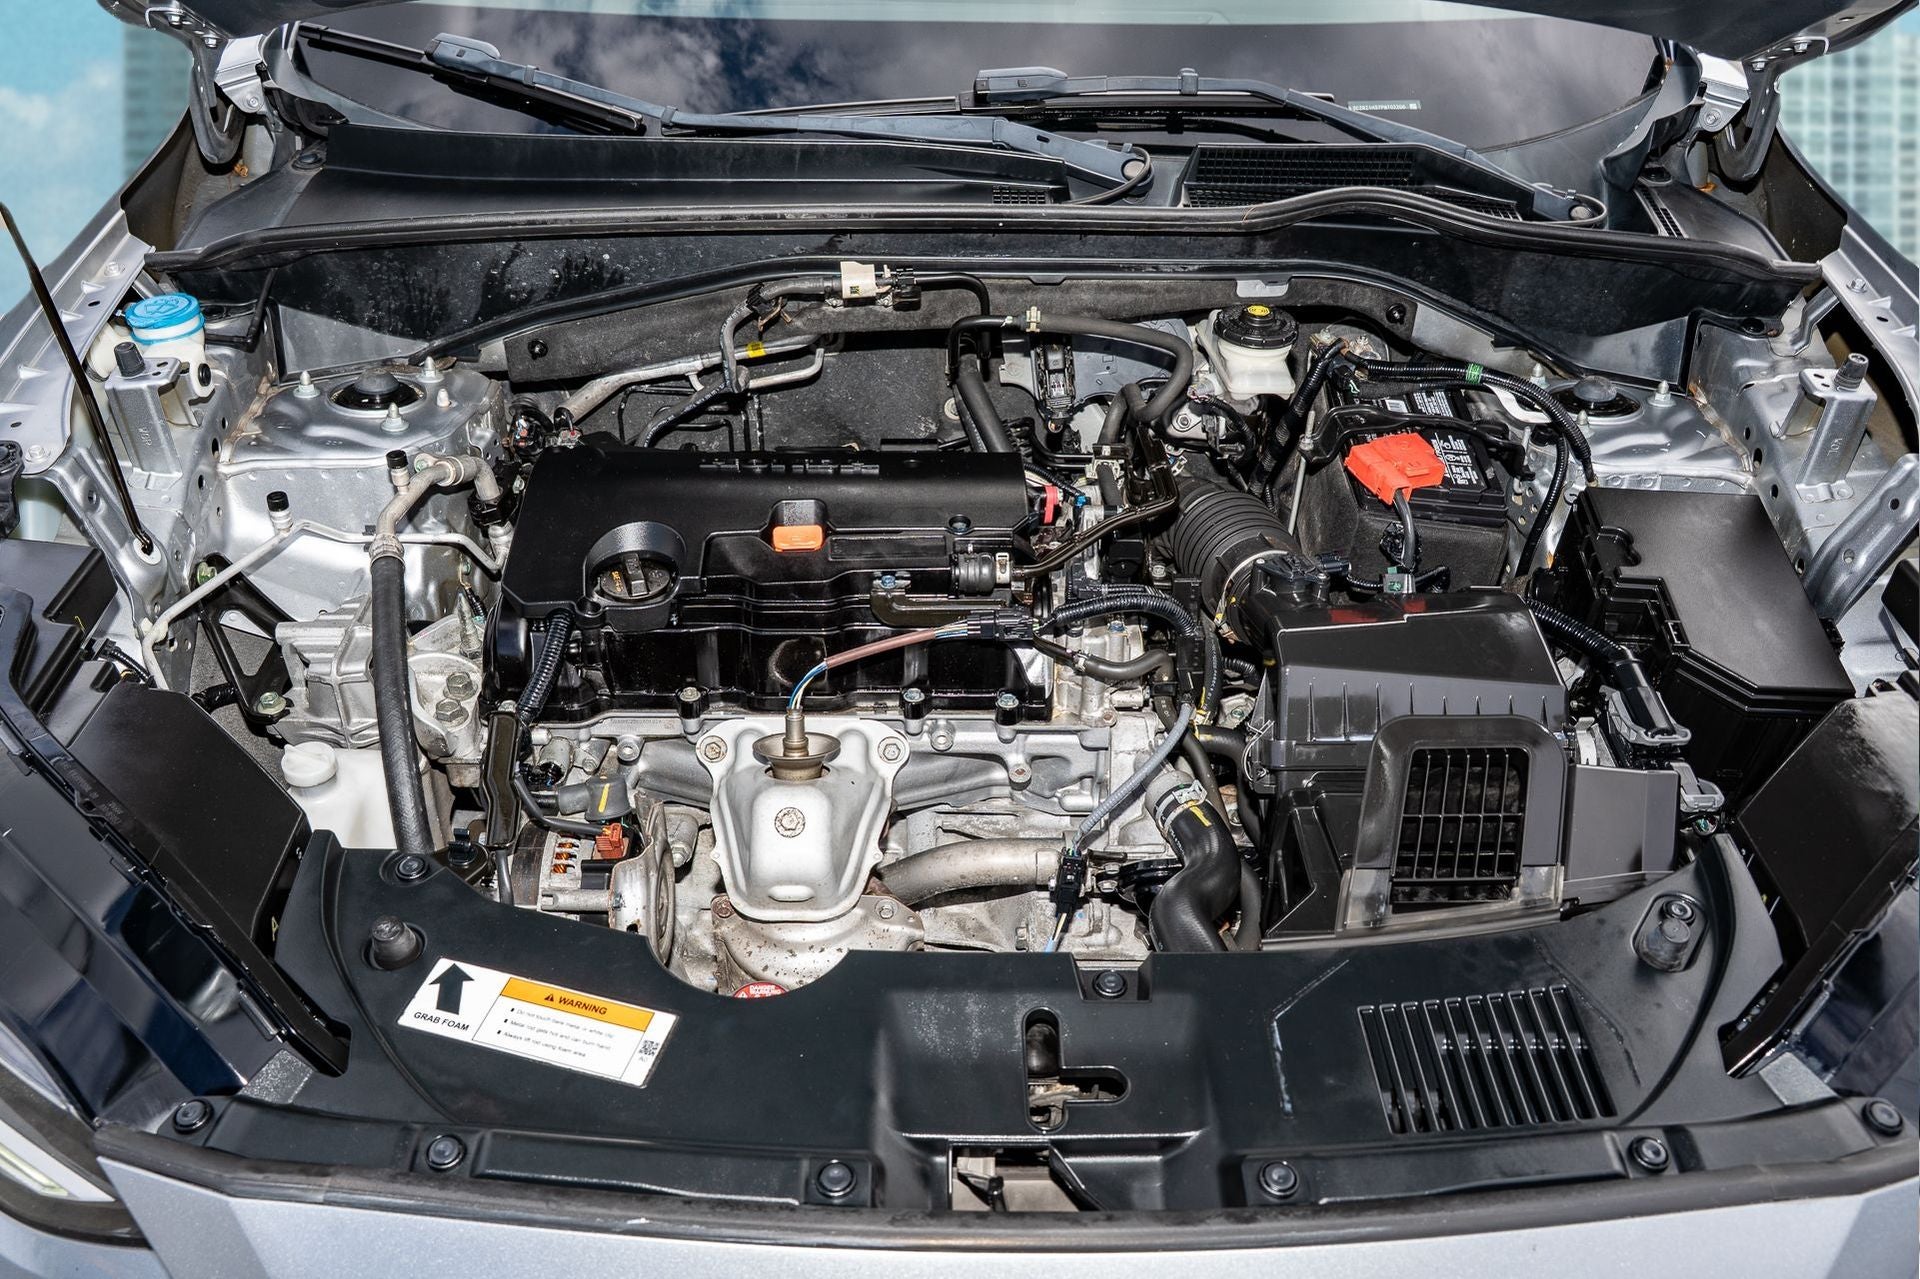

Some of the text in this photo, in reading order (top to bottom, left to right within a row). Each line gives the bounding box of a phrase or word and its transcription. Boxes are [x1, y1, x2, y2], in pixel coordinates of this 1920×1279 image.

[558, 996, 607, 1016] WARNING
[413, 1011, 470, 1031] GRAB FOAM
